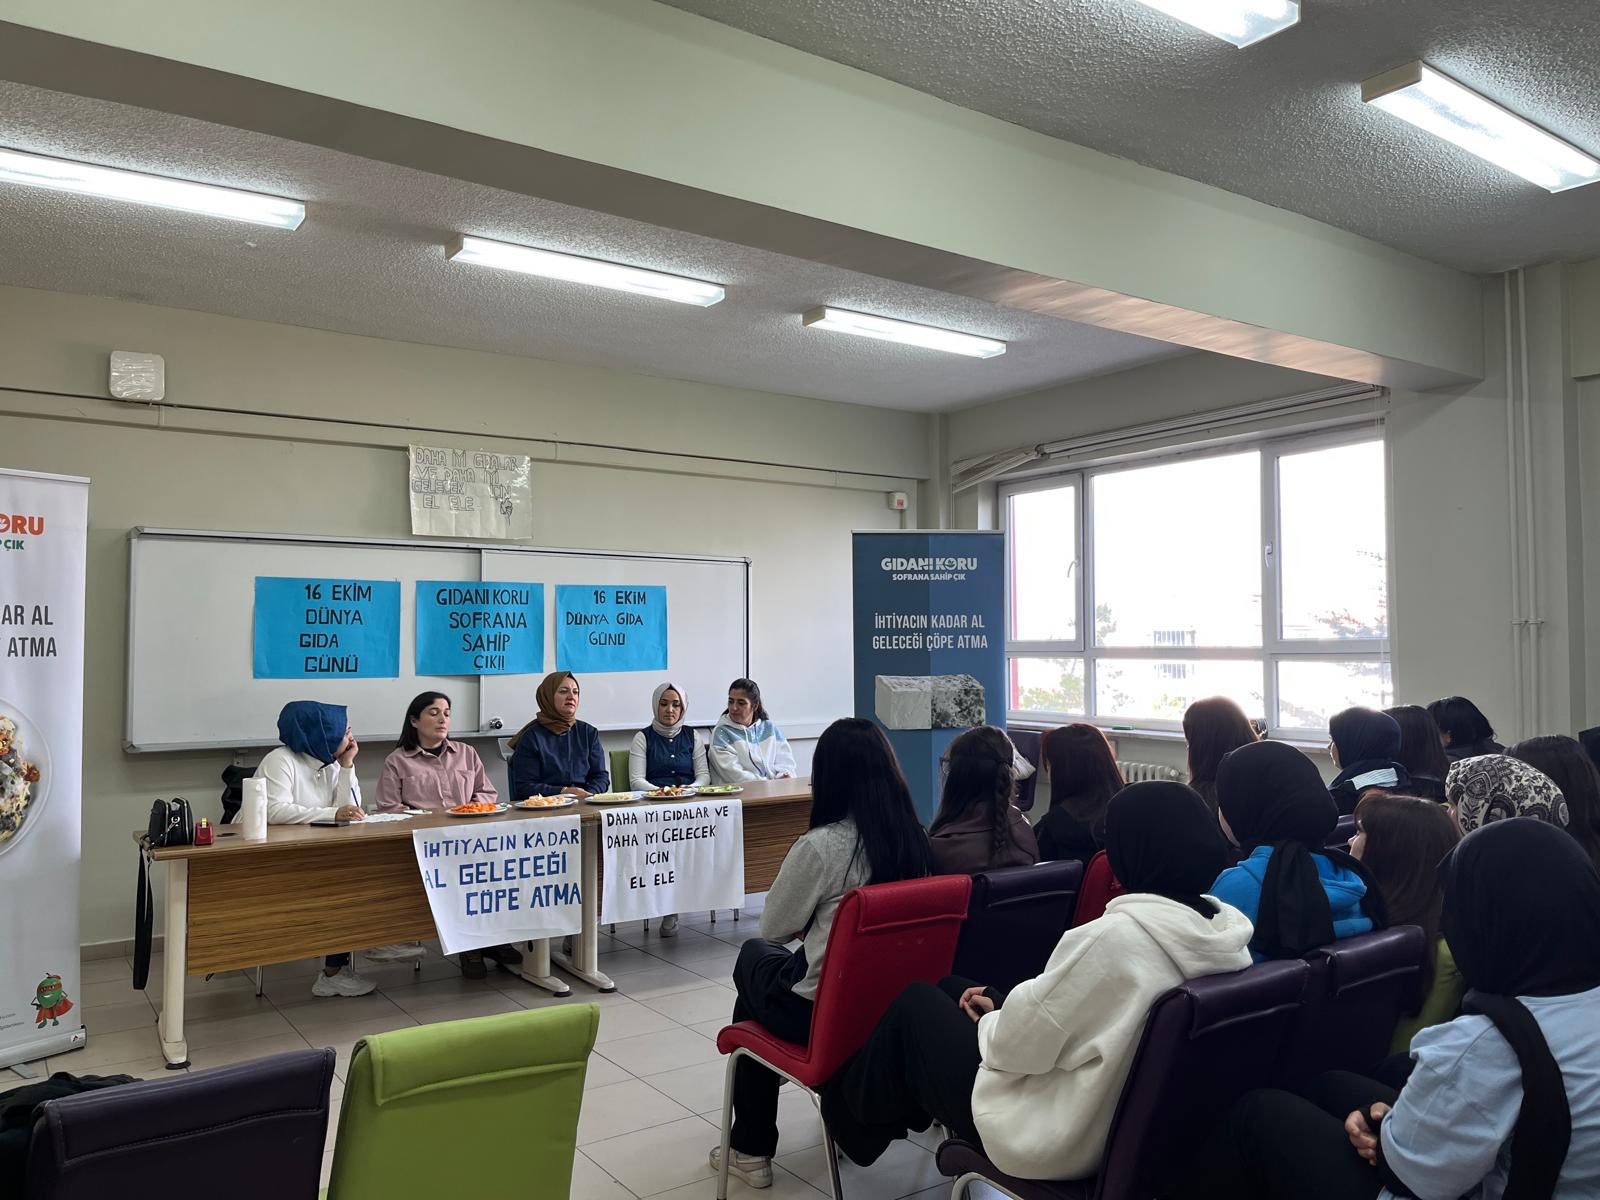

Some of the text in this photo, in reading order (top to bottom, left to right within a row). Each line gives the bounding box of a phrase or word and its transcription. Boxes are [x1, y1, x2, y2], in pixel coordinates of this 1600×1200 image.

[416, 448, 447, 467] DAHA
[415, 466, 437, 479] VE
[444, 468, 475, 483] DAHA
[423, 494, 475, 511] EL ELE
[881, 557, 978, 571] GIDANI KORU
[892, 572, 966, 582] SOFRANA SAHİP ÇIK
[305, 583, 372, 602] 16 EKİM
[436, 588, 529, 605] GIDANI KORU
[593, 590, 646, 605] 16 EKİM
[31, 605, 54, 625] AL
[305, 606, 363, 625] DÜNYA
[449, 611, 528, 629] SOFRANA
[566, 611, 644, 626] DÜNYA GIDA
[874, 612, 985, 629] İHTİYACIN KADAR AL
[7, 637, 57, 657] ATMA
[300, 633, 339, 648] GIDA
[462, 632, 511, 652] SAHİP
[872, 633, 988, 652] GELECEĞİ ÇÖPE ATMA
[304, 654, 359, 673] GÜNÜ
[607, 812, 638, 827] DAHA
[663, 806, 709, 822] GIDALAR
[715, 805, 729, 817] VE
[423, 828, 579, 859] İHTİYACIN KADAR
[607, 834, 638, 849] DAHA
[662, 824, 717, 844] GELECEK
[425, 851, 567, 889] AL GELECEĞİ
[630, 871, 675, 889] EL ELE
[465, 882, 582, 917] ÇÖPE ATMA
